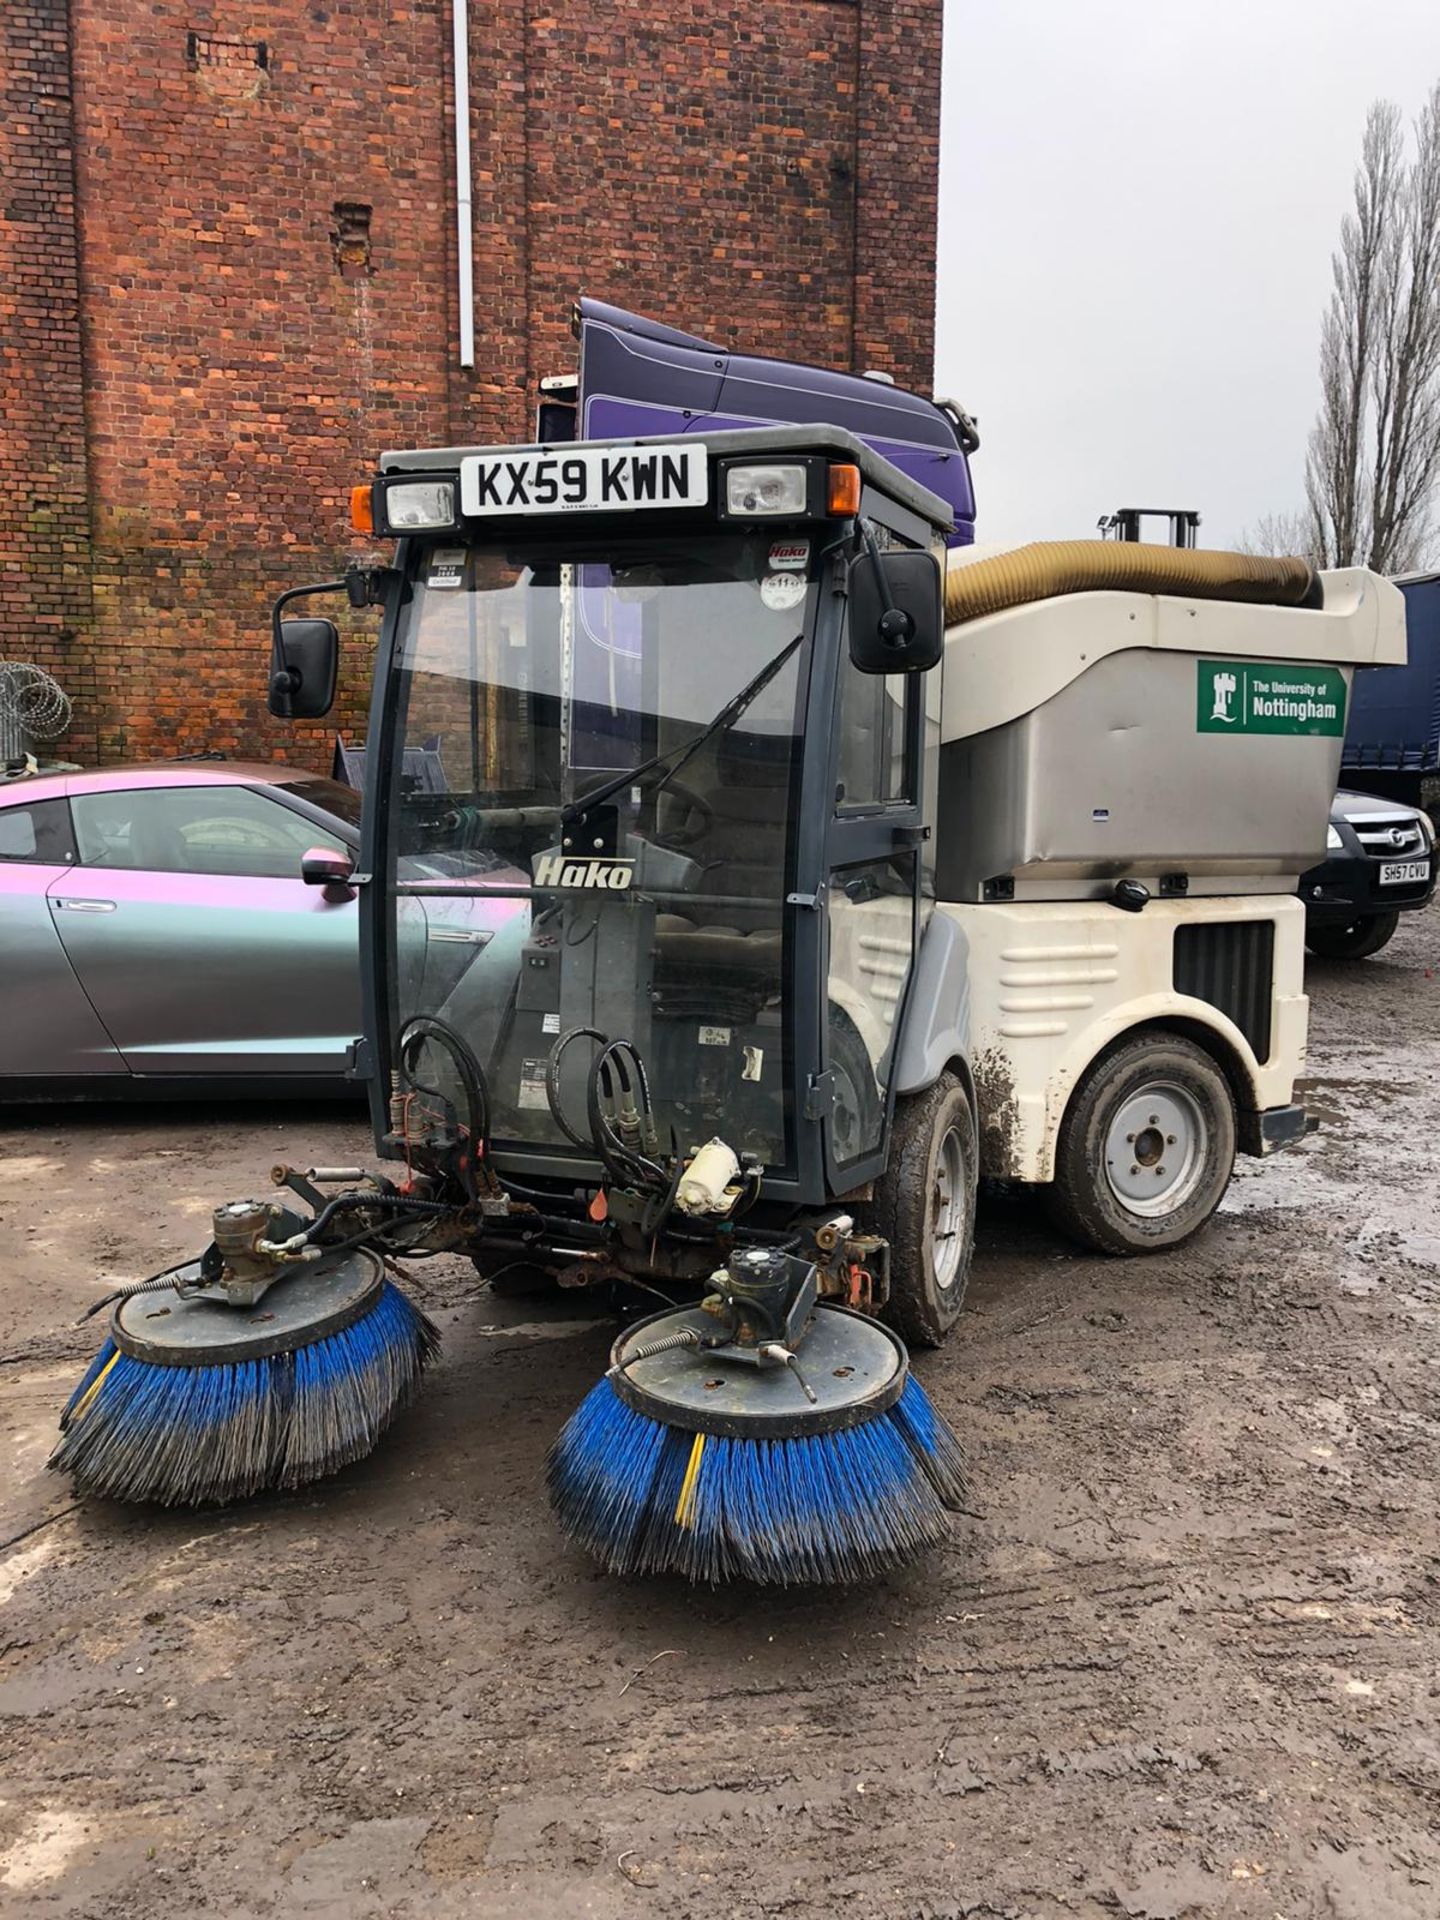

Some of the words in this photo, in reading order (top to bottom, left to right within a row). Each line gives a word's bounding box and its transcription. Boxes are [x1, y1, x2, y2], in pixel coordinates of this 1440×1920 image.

[478, 459, 588, 507] KX59
[601, 453, 689, 502] KWN
[768, 544, 807, 558] Hako
[1253, 680, 1270, 693] The
[1271, 681, 1315, 698] University
[1317, 684, 1328, 696] of
[1253, 696, 1337, 723] Nottingham
[534, 856, 636, 890] Hako
[1384, 865, 1407, 881] SH57
